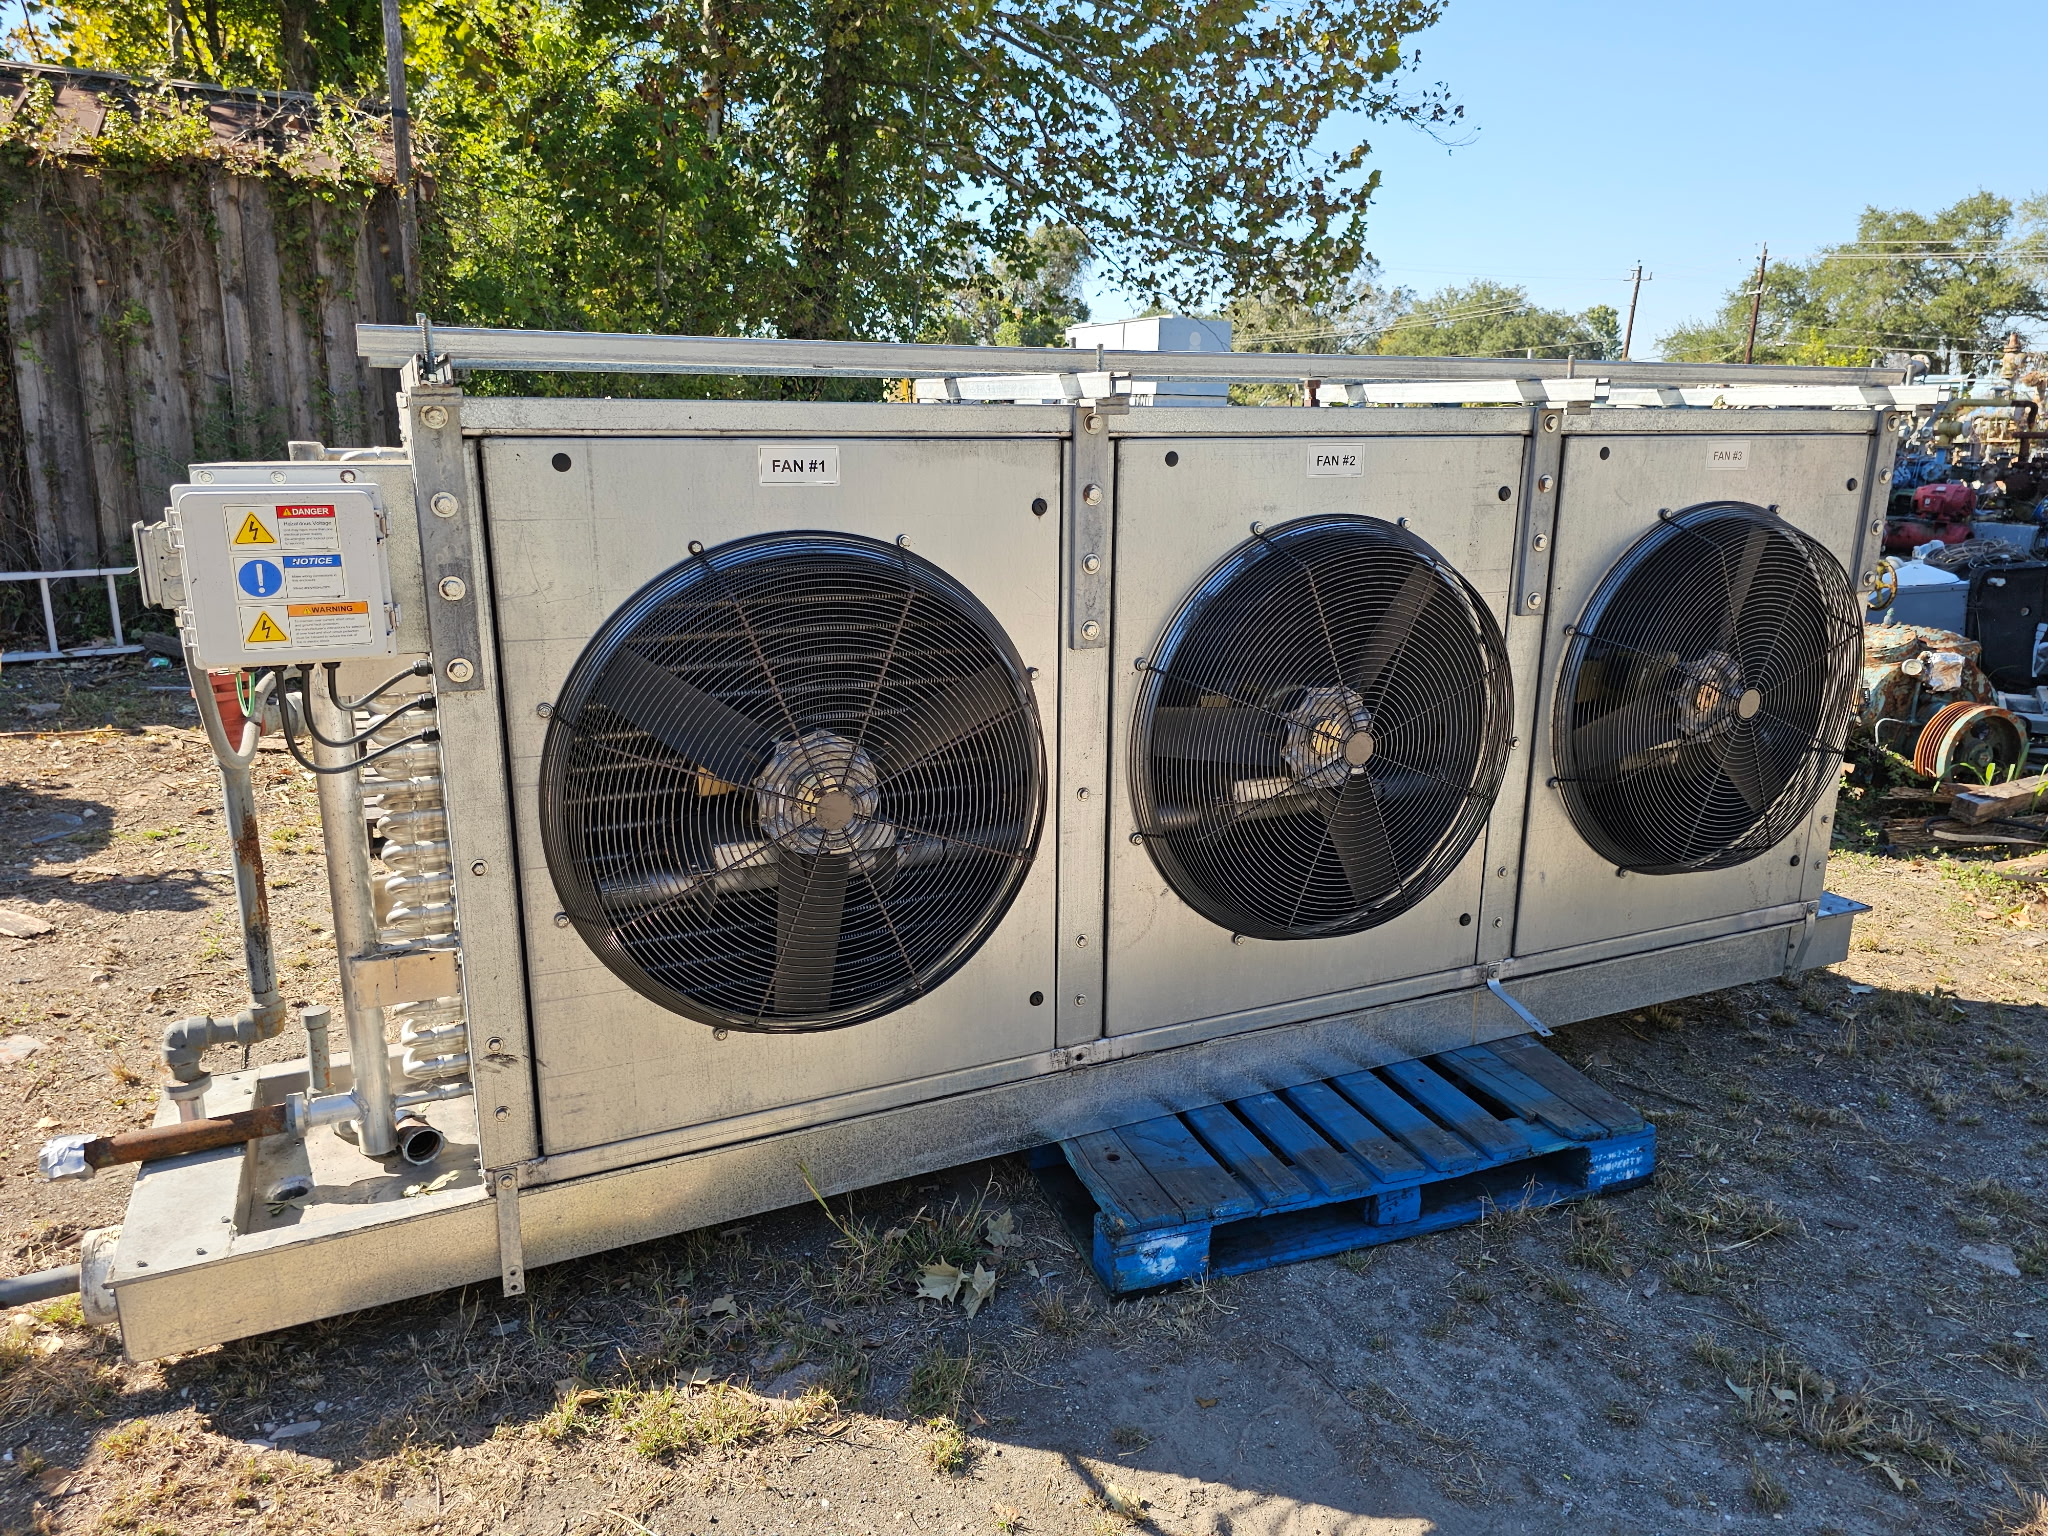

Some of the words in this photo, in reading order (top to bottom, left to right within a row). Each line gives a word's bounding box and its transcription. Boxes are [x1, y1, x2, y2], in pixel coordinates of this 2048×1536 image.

[1316, 455, 1339, 466] FAN
[1342, 454, 1356, 466] #2
[1713, 451, 1731, 460] FAN
[1732, 450, 1743, 461] #3
[772, 459, 804, 473] FAN
[808, 459, 825, 473] #1
[291, 507, 329, 516] DANGER
[292, 557, 333, 565] NOTICE
[311, 604, 353, 613] WARNING
